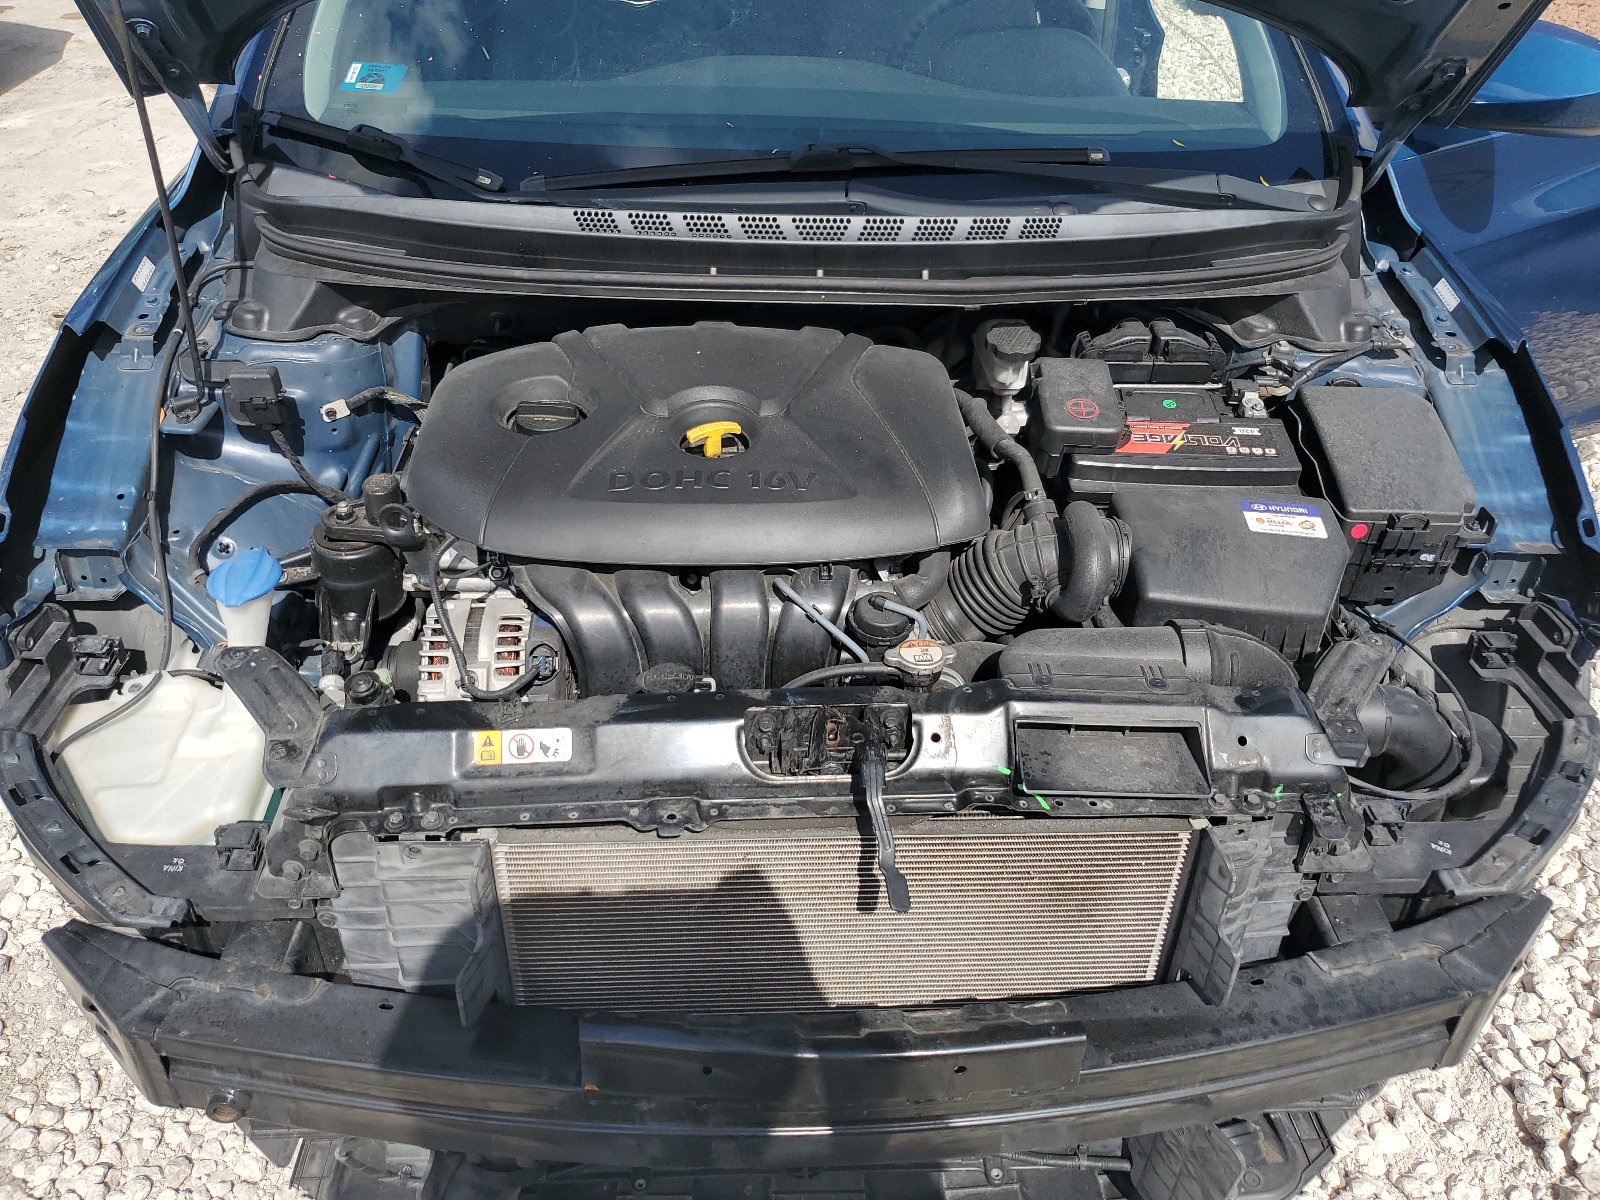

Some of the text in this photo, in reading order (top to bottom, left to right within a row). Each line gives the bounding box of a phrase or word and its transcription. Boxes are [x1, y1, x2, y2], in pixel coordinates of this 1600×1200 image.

[1132, 431, 1241, 448] VOLTAGE
[607, 469, 818, 492] DOHC 16V
[1268, 505, 1309, 514] HYUNDAI
